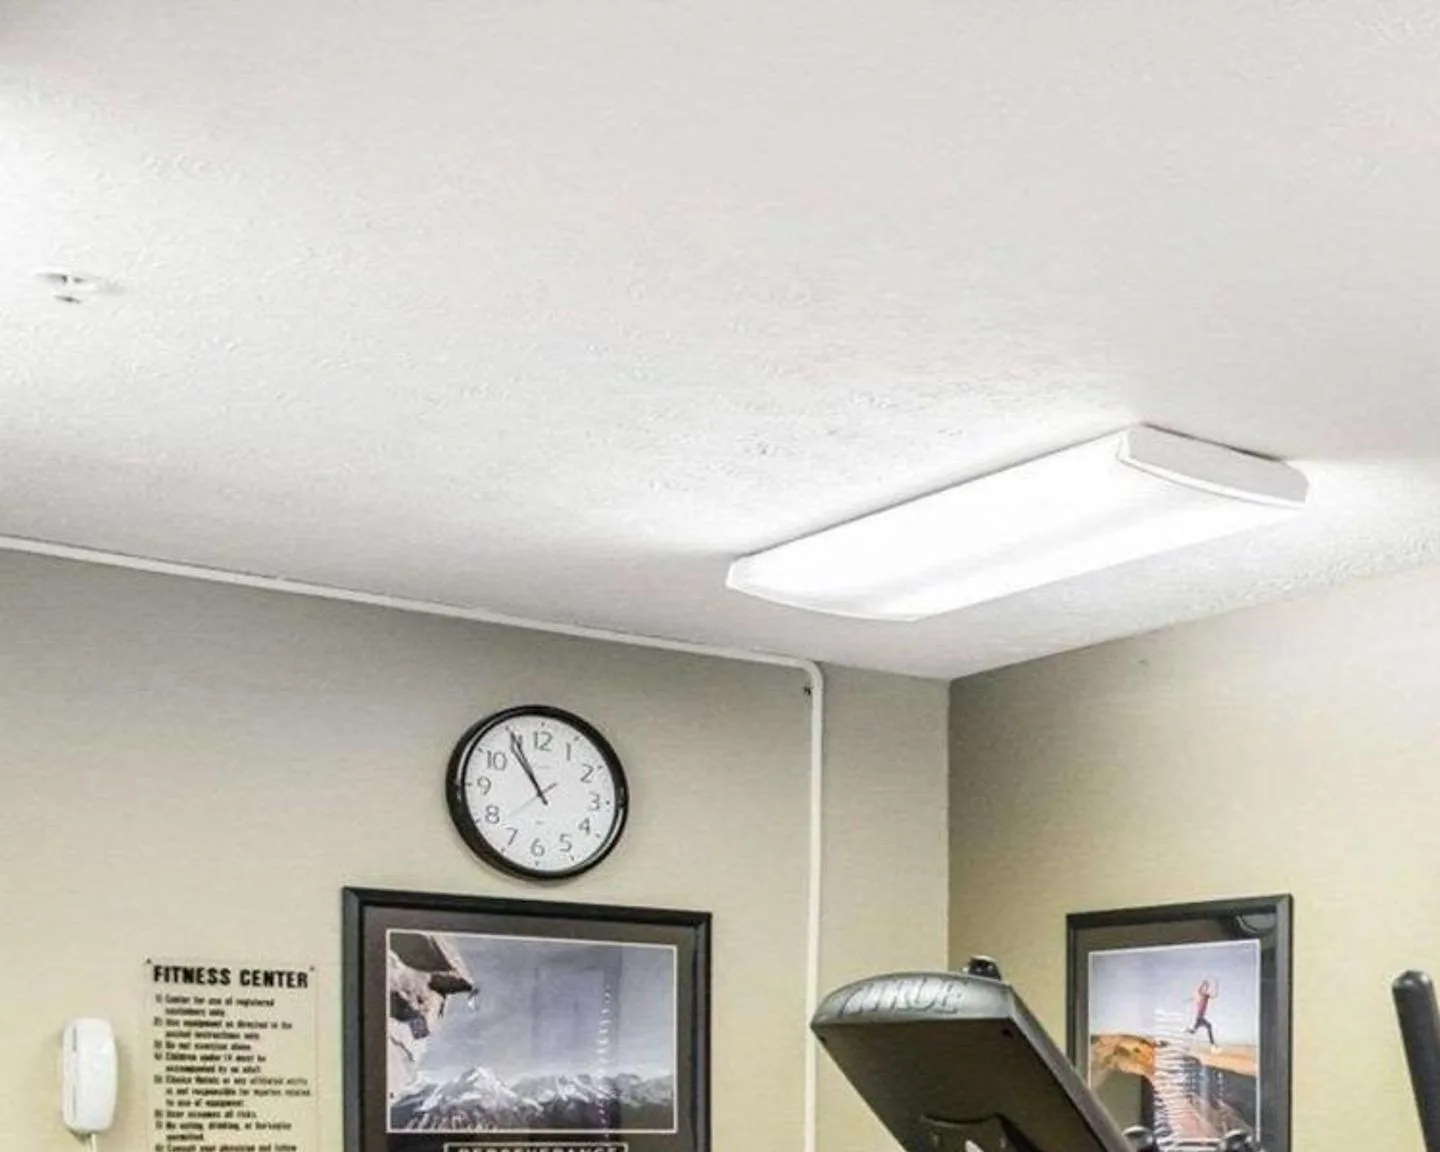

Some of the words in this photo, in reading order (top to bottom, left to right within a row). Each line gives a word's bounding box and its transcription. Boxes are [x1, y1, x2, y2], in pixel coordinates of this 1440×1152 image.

[533, 731, 552, 751] 12
[487, 750, 507, 771] 10
[565, 742, 571, 761] 1
[580, 764, 595, 783] 2
[476, 776, 491, 796] 9
[588, 791, 600, 811] 3
[485, 805, 500, 824] 8
[505, 826, 518, 845] 7
[578, 817, 591, 835] 4
[531, 838, 545, 857] 6
[559, 833, 572, 852] 5
[153, 965, 231, 986] FITNESS
[240, 969, 308, 988] CENTER
